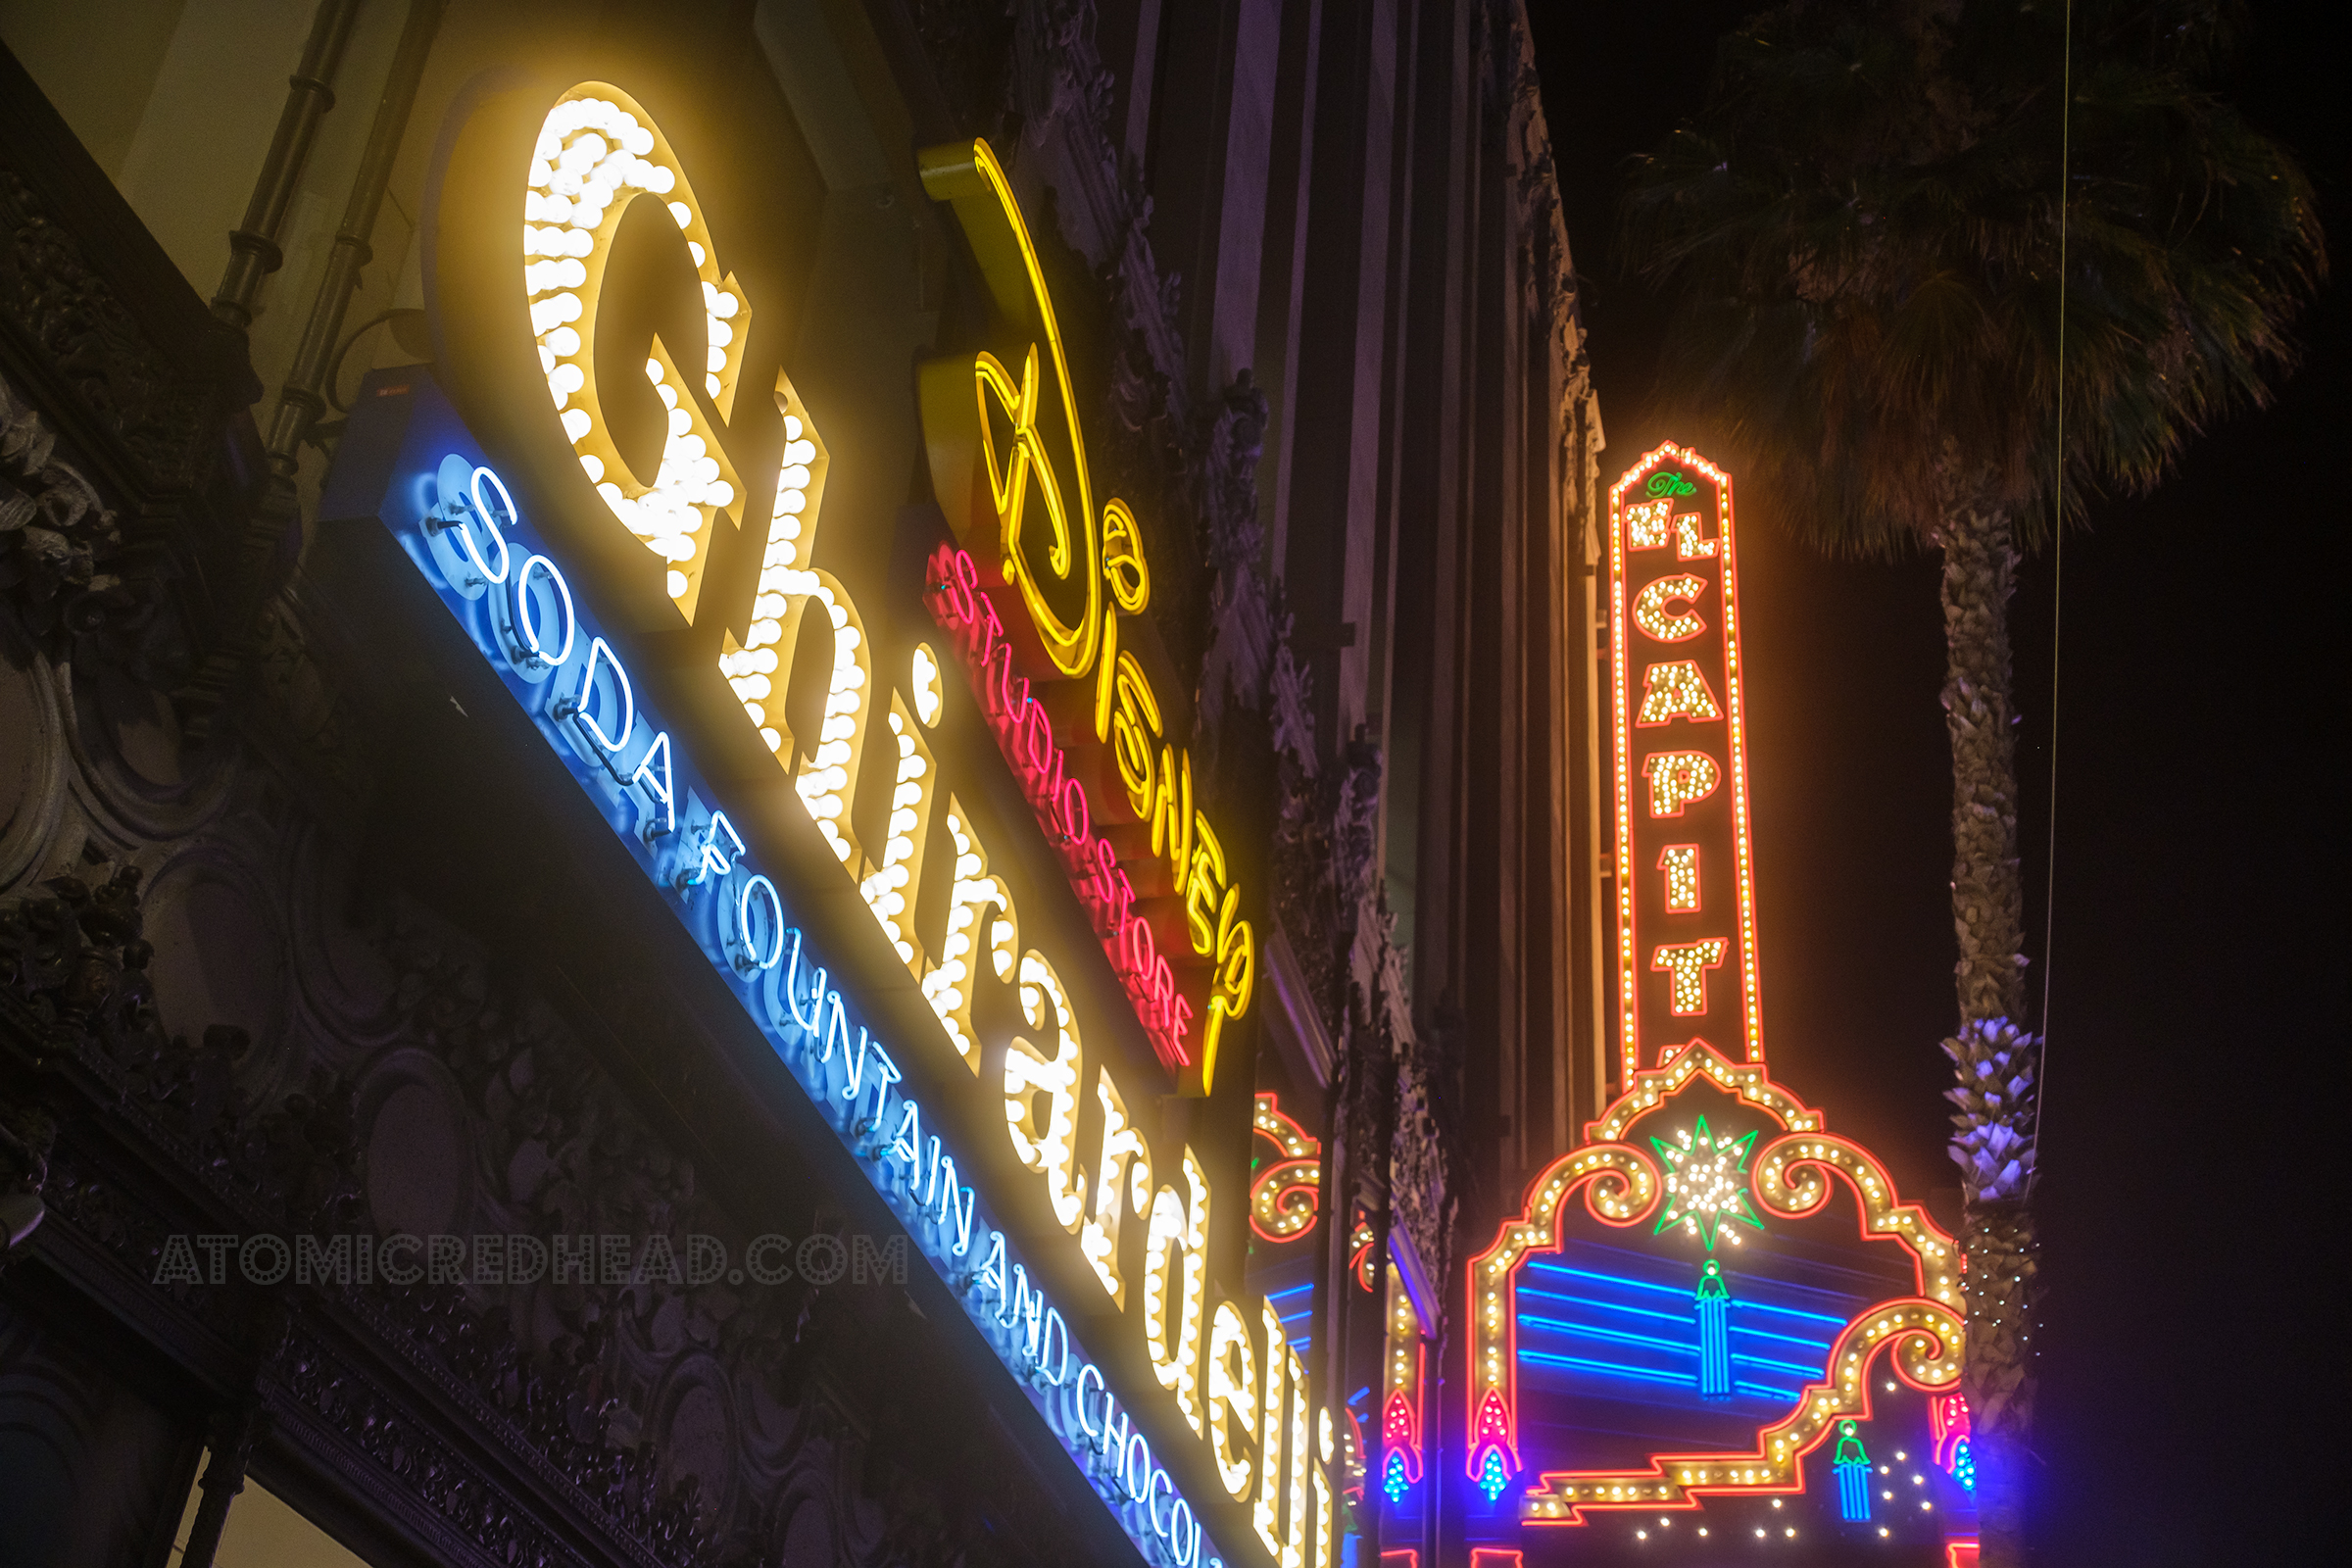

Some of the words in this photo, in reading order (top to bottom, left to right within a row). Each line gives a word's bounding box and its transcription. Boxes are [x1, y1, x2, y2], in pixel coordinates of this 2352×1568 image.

[972, 136, 1254, 1097] Disney
[1623, 497, 1722, 563] EL
[1644, 470, 1697, 500] The
[436, 459, 678, 845] SODA
[686, 808, 975, 1257] FOUNTAIN
[970, 1230, 1069, 1388] AND
[1075, 1363, 1223, 1567] CHOCOL
[523, 80, 1335, 1567] Ghirardelli
[938, 545, 1090, 847] STUDIO
[1094, 837, 1195, 1068] STORE
[1631, 571, 1731, 1068] CAPIT
